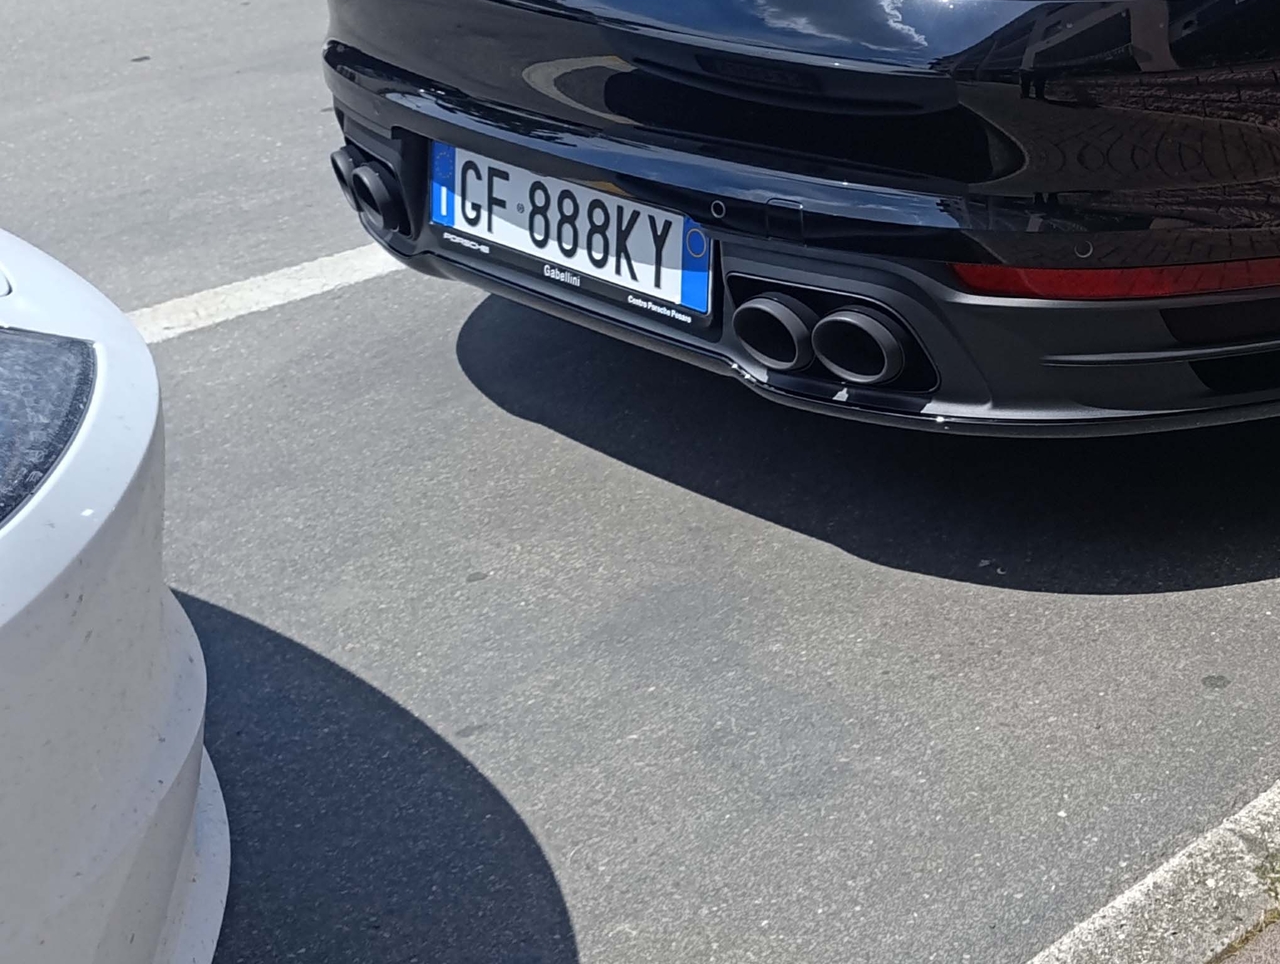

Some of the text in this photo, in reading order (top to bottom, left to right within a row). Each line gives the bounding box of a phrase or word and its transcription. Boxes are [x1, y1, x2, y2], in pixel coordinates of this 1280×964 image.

[461, 160, 510, 234] GF
[528, 181, 673, 290] 888KY
[543, 264, 581, 287] Gabellini
[627, 295, 648, 308] Centro
[647, 301, 671, 316] Porsche
